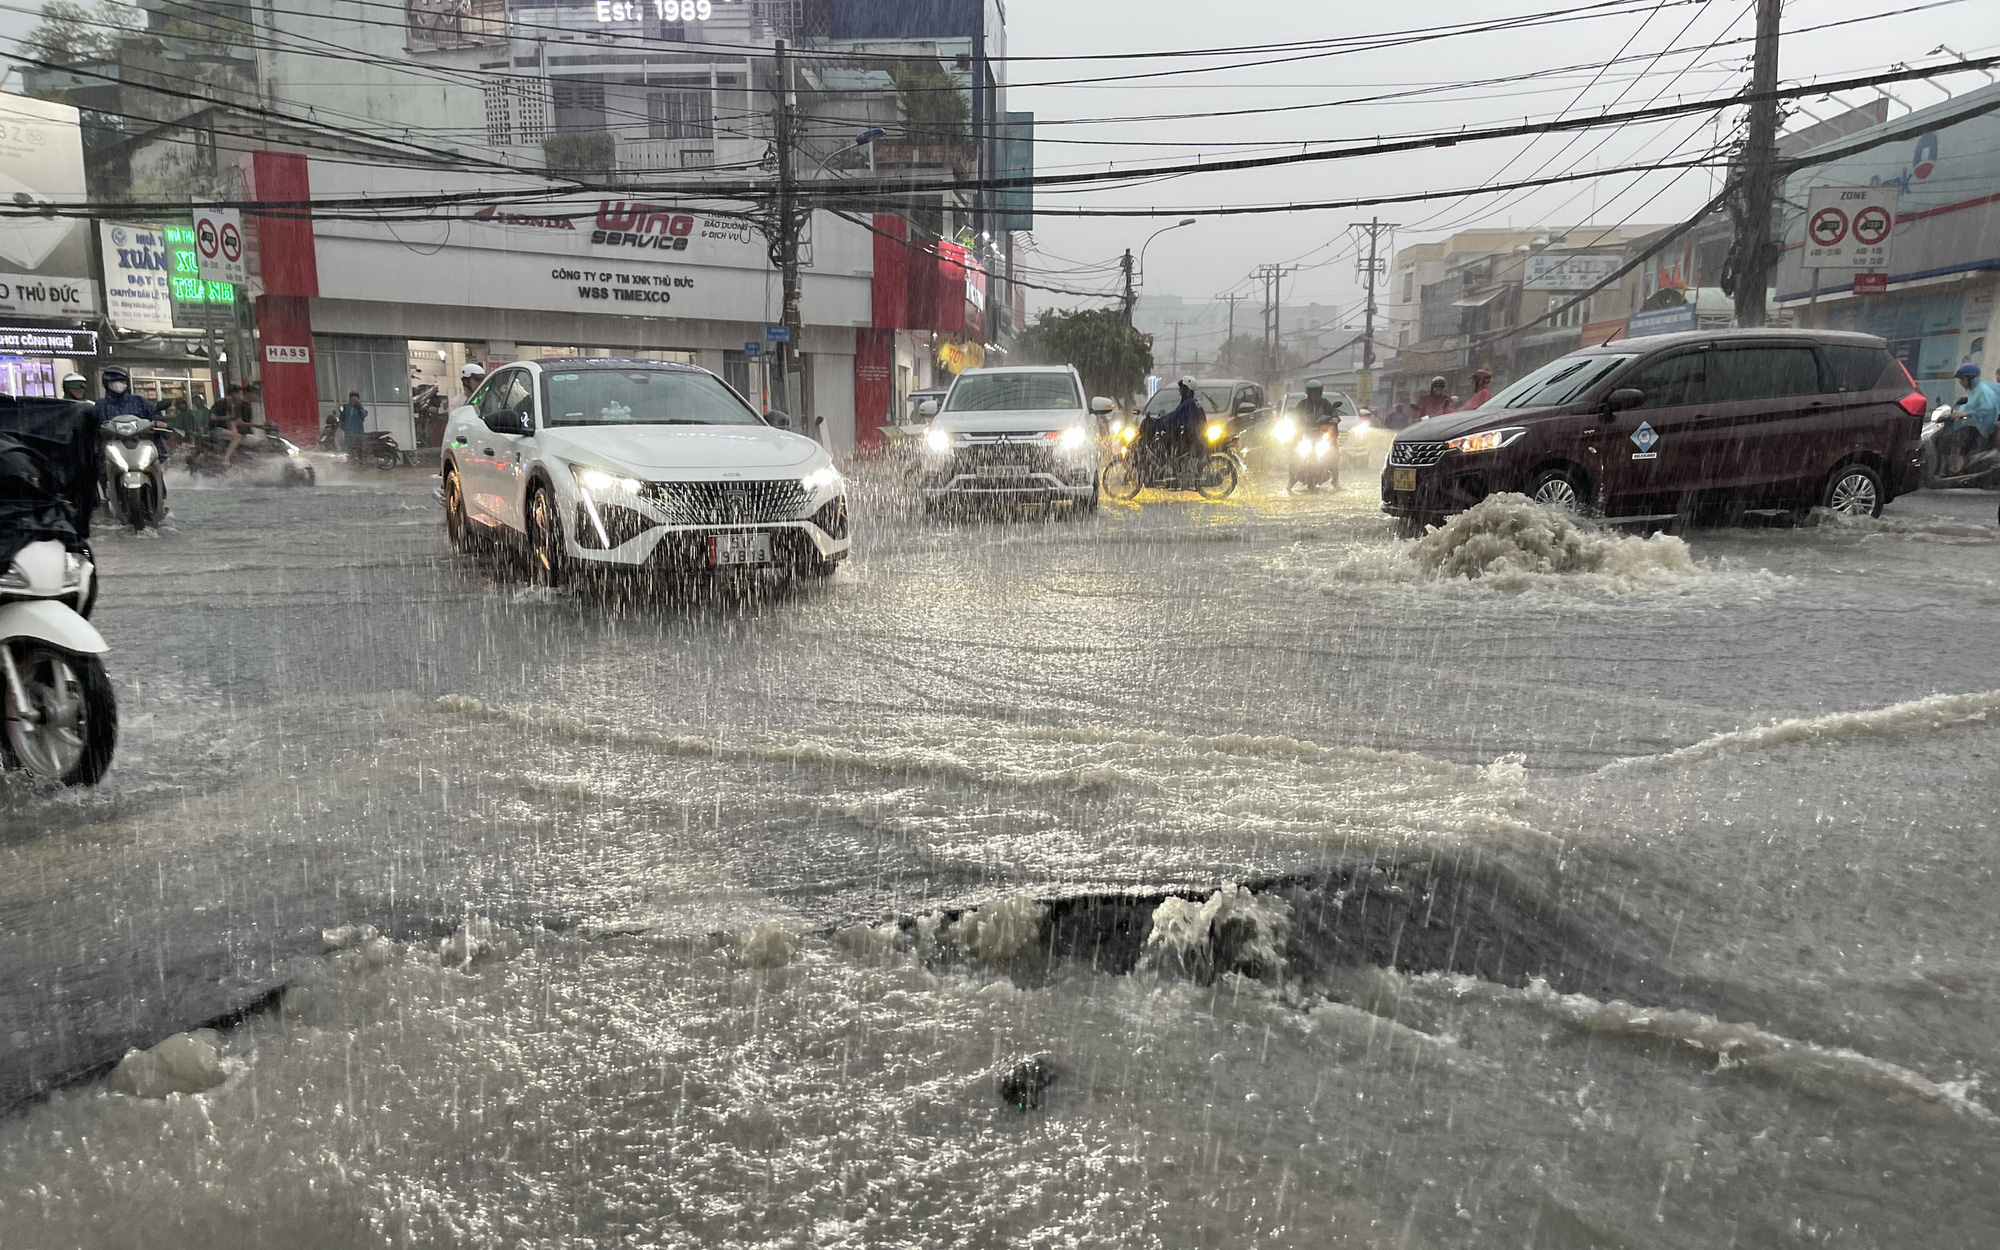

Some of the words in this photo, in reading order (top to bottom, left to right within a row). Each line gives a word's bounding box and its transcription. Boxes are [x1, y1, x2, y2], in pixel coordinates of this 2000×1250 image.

[596, 0, 642, 22] Est.
[653, 0, 712, 21] 1989
[1840, 191, 1868, 200] ZONE
[497, 211, 576, 230] HONDA
[595, 200, 694, 237] WING
[591, 230, 689, 251] SERVICE
[551, 267, 581, 280] CÔNG
[583, 271, 597, 282] TY
[599, 272, 613, 283] CP
[615, 273, 630, 284] TM
[632, 274, 651, 285] XNK
[653, 275, 671, 287] THỦ
[674, 276, 694, 288] ĐỨC
[16, 281, 46, 302] THỦ
[49, 284, 80, 303] ĐỨC
[578, 286, 609, 299] WSS
[612, 288, 671, 303] TIMEXCO
[21, 333, 47, 346] CÔNG
[269, 347, 306, 358] HASS
